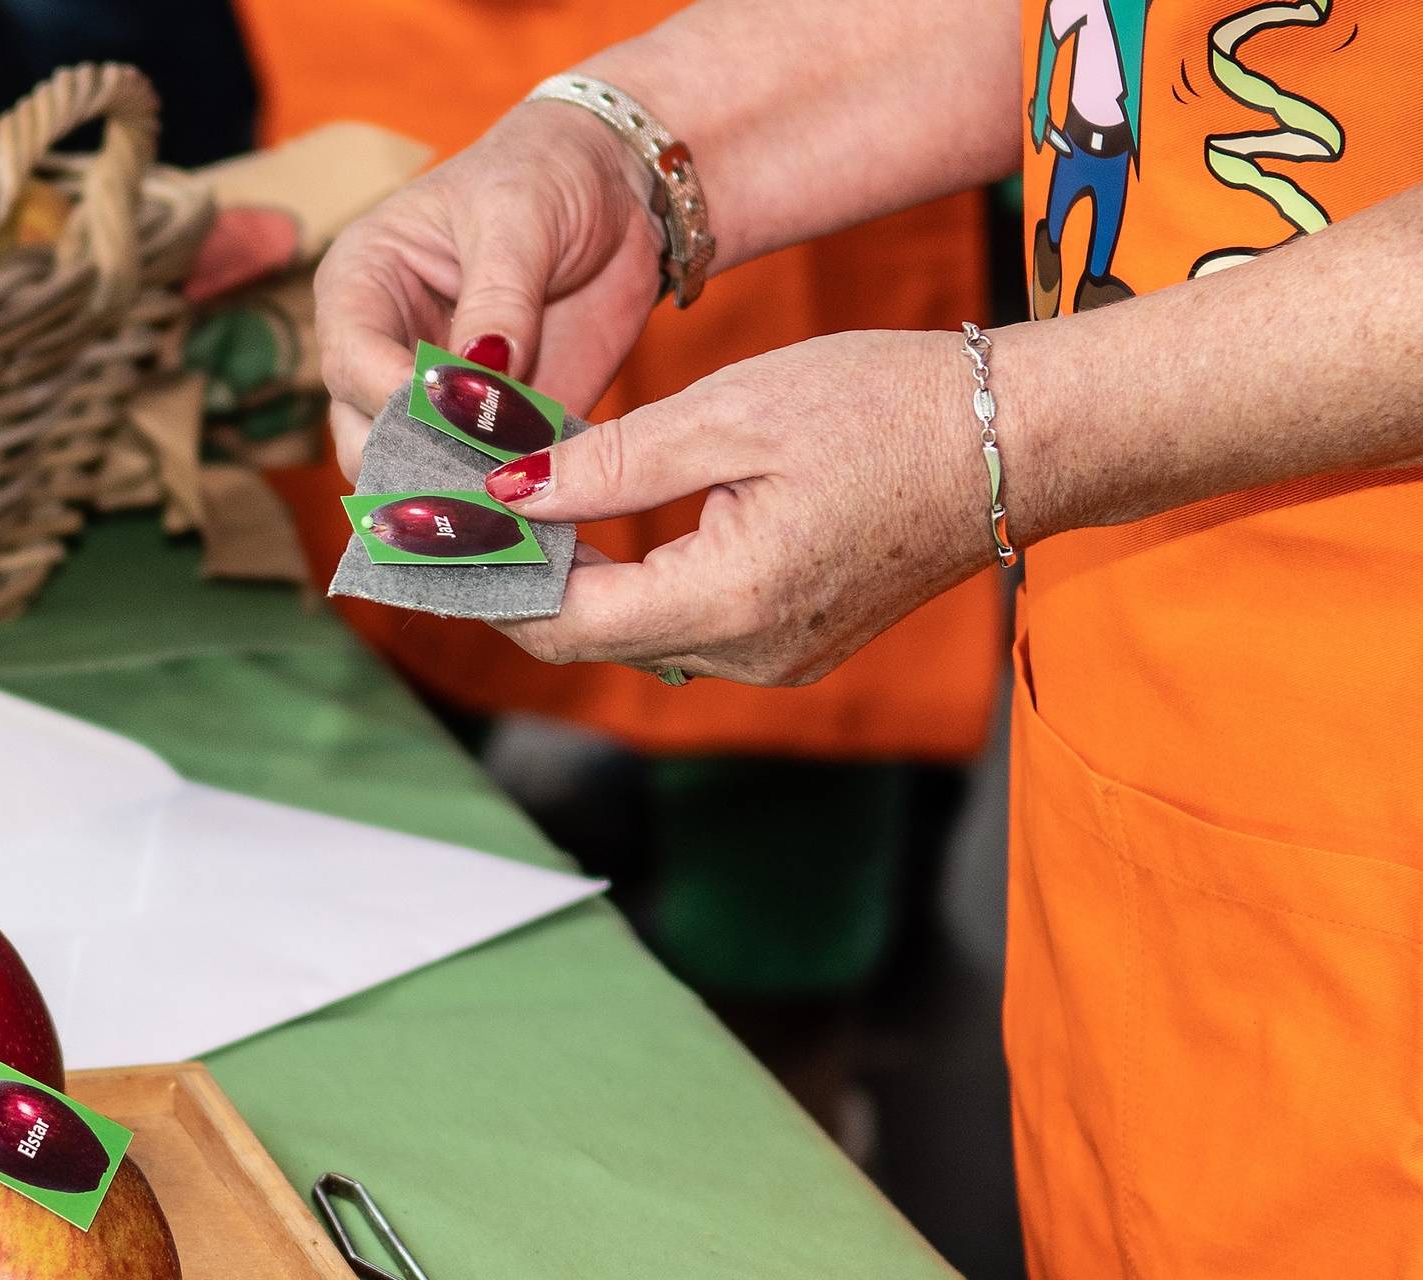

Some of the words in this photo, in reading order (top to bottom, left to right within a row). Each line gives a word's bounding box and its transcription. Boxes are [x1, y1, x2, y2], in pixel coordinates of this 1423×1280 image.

[477, 386, 501, 432] Wellant
[434, 515, 456, 538] Jazz
[17, 1117, 50, 1159] Elstar
